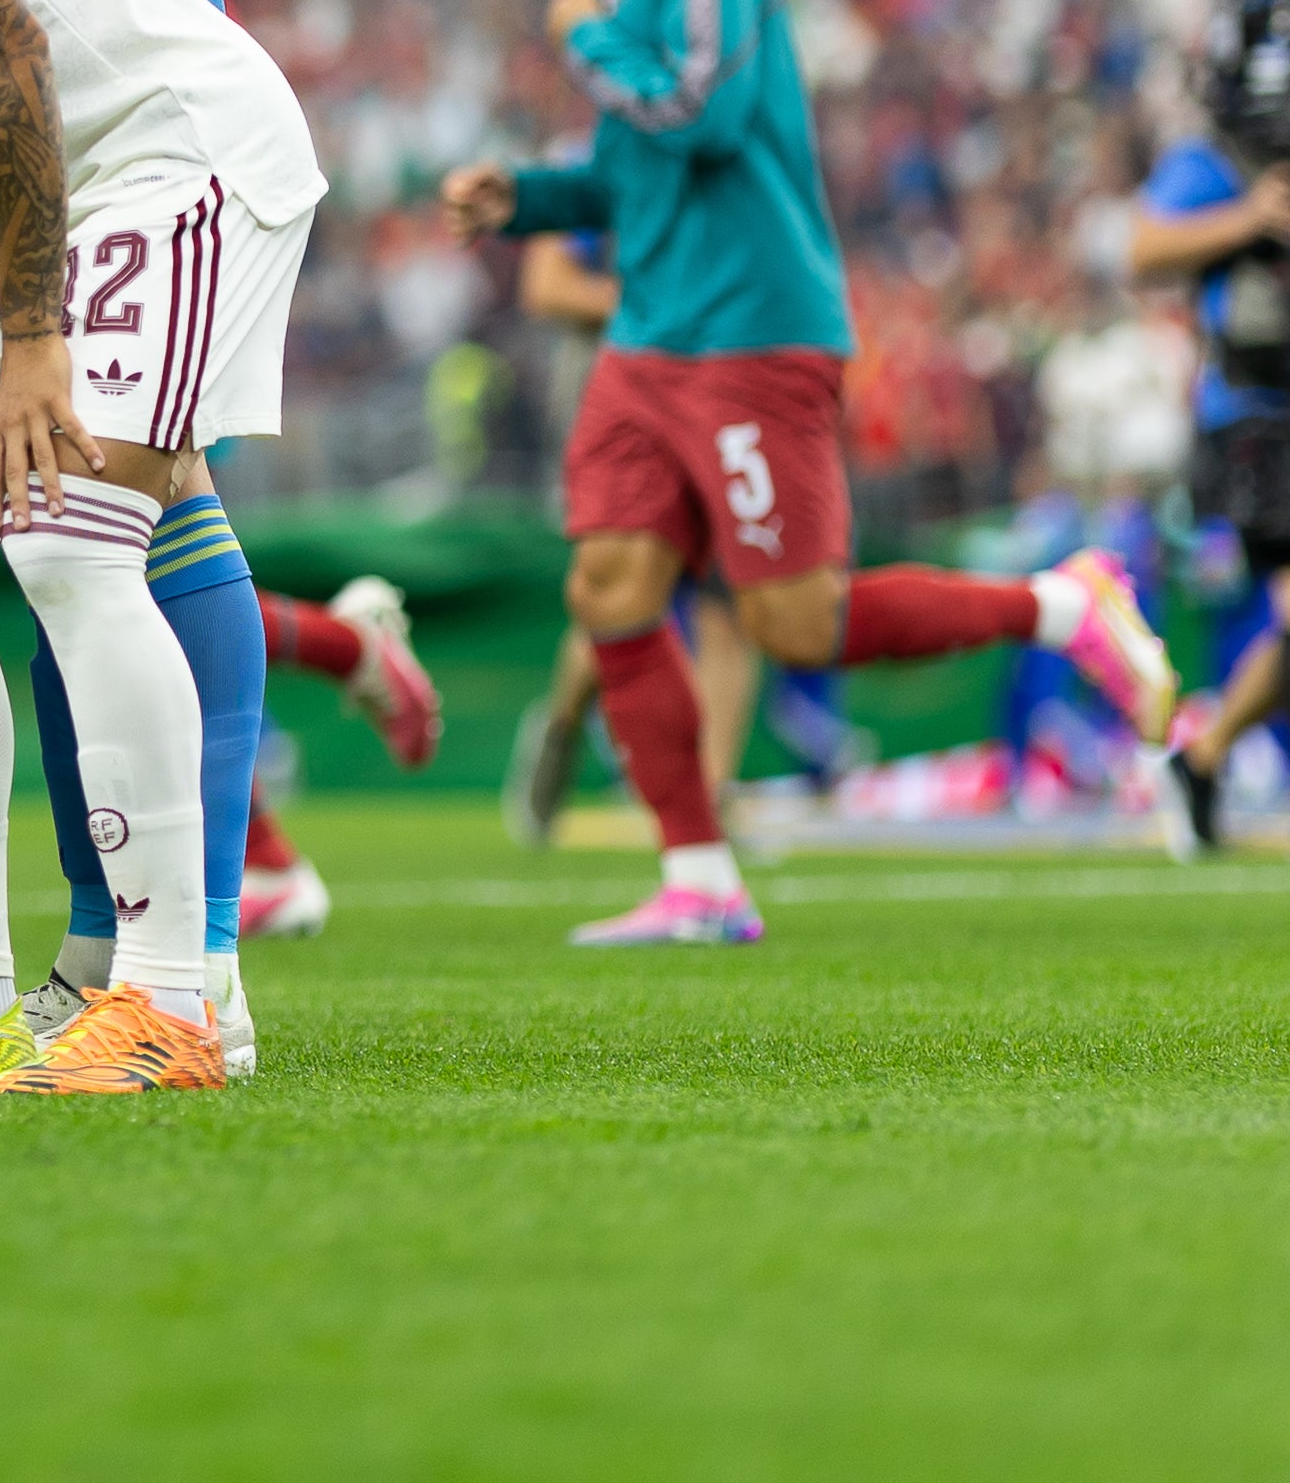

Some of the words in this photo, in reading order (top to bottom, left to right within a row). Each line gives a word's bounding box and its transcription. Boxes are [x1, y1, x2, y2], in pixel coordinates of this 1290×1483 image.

[715, 421, 776, 523] 5
[91, 817, 113, 832] RF
[93, 831, 116, 844] EF
